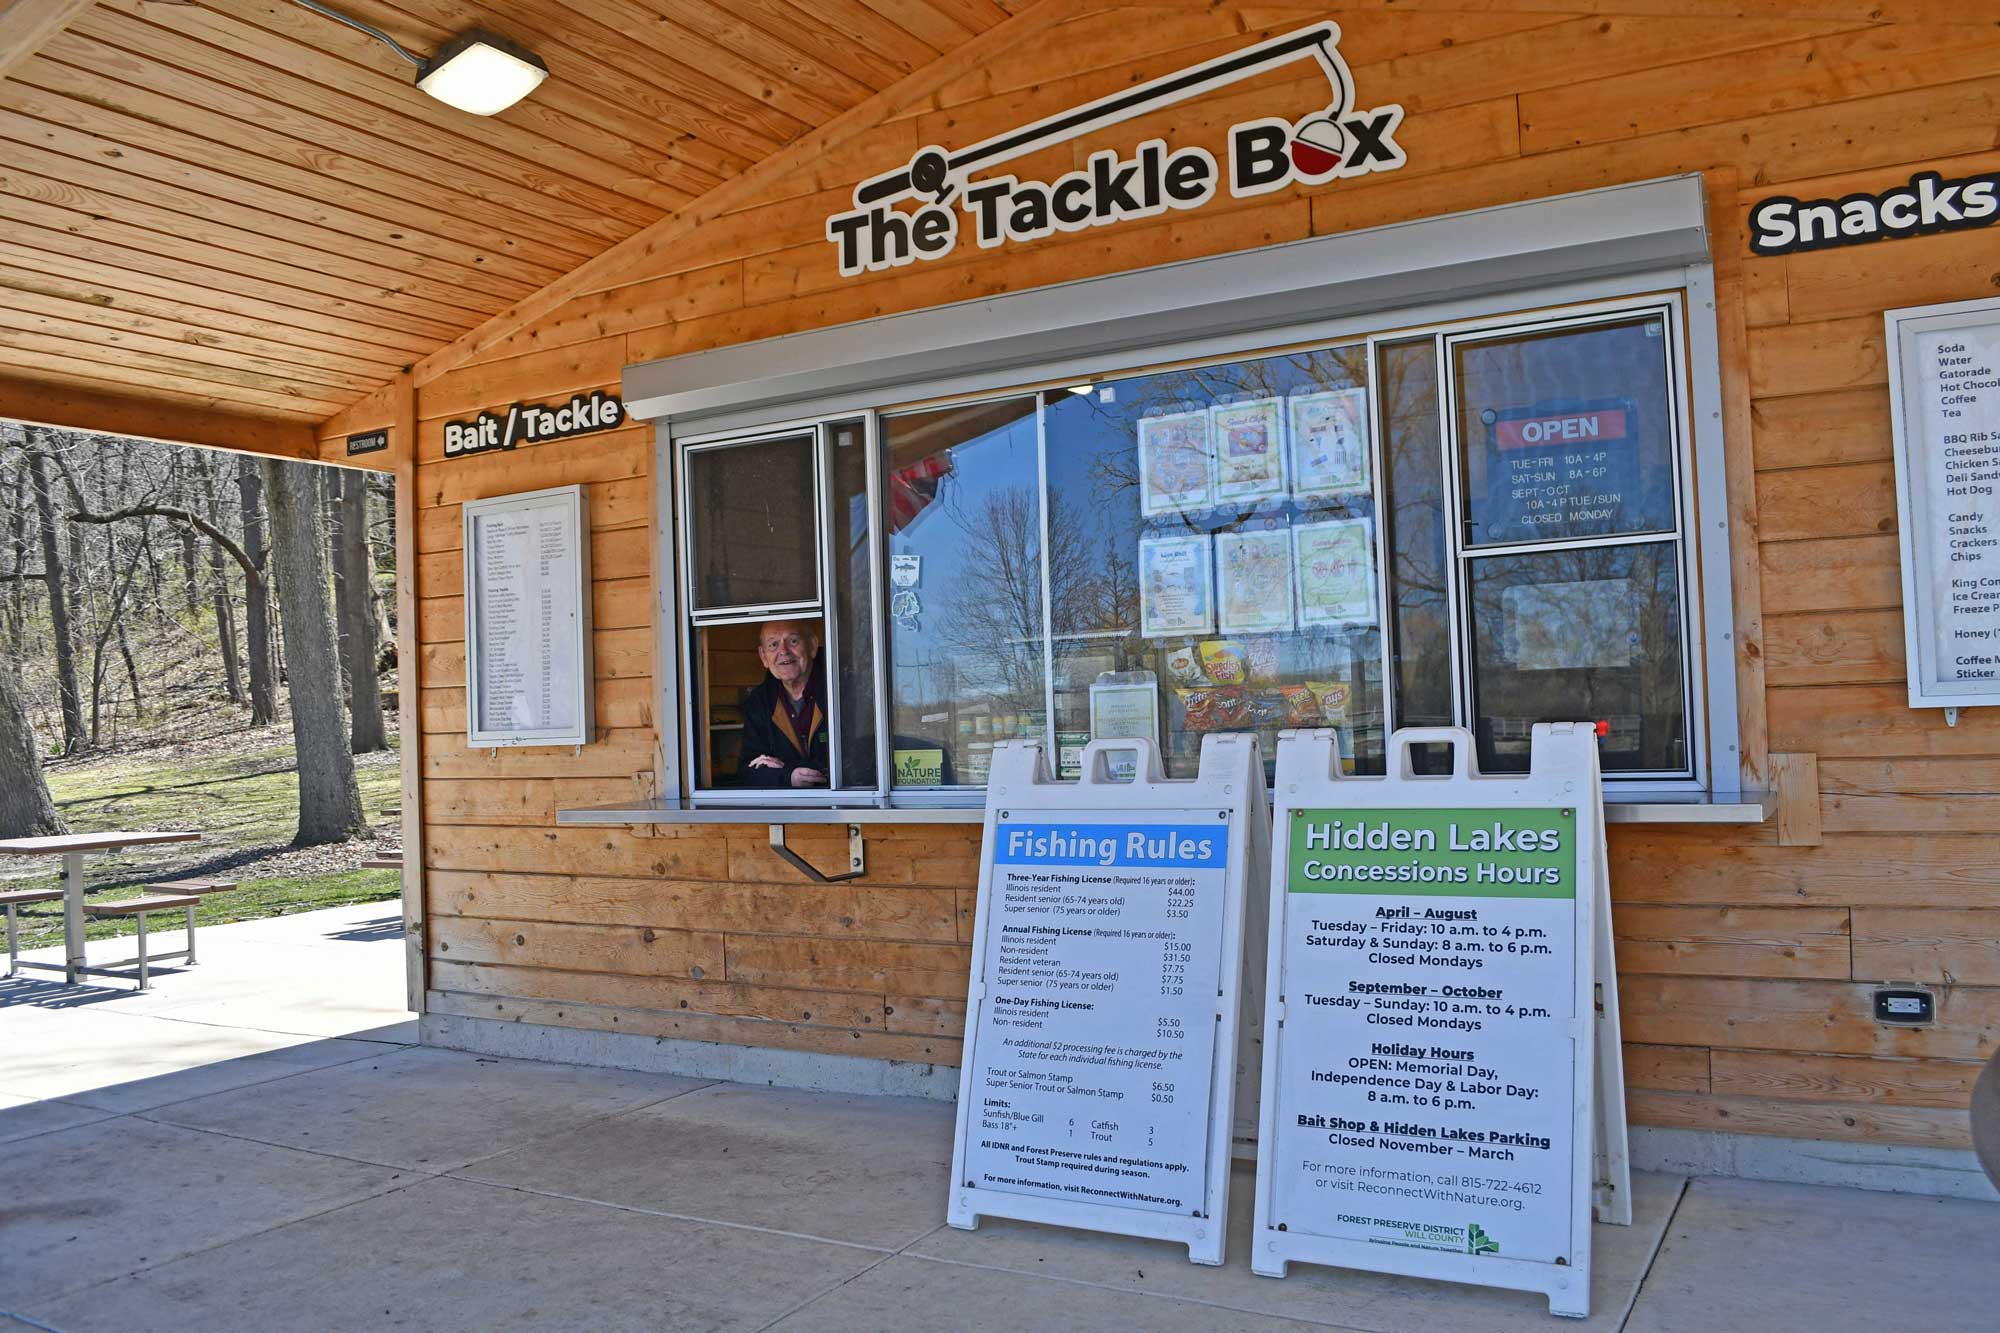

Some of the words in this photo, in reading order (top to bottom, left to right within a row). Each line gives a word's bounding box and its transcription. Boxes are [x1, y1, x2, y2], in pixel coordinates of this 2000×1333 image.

[831, 205, 950, 268] The
[967, 147, 1208, 241] Tackle
[1236, 113, 1398, 189] Box
[1757, 178, 1997, 247] Snacks
[1938, 344, 1965, 354] Soda
[1939, 357, 1972, 366] Water
[1940, 366, 1991, 379] Gatorade
[1940, 384, 1960, 392] Hot
[1941, 395, 1976, 405] Coffee
[1942, 410, 1962, 418] Tea
[446, 416, 498, 453] Bait
[522, 396, 618, 437] Tackle
[1522, 416, 1598, 442] OPEN
[1944, 434, 1967, 444] BBQ
[1970, 432, 1988, 442] Rib
[1946, 458, 1989, 470] Chicken
[1946, 474, 1968, 483] Deli
[1947, 487, 1967, 496] Hot
[1970, 486, 1992, 496] Dog
[1522, 513, 1562, 524] CLOSED
[1570, 509, 1613, 521] MONDAY
[1948, 512, 1984, 522] Candy
[1949, 524, 1988, 536] Snacks
[1950, 538, 1998, 549] Crackers
[1951, 552, 1982, 562] Chips
[1952, 578, 1977, 590] King
[1954, 604, 1990, 614] Freeze
[1955, 630, 1990, 640] Honey
[1956, 656, 1992, 665] Coffee
[1956, 669, 1995, 678] Sticker
[898, 768, 940, 778] NATURE
[1306, 820, 1434, 849] Hidden
[1449, 822, 1558, 850] Lakes
[1008, 830, 1116, 865] Fishing
[1126, 831, 1212, 859] Rules
[1303, 859, 1467, 881] Concessions
[1476, 862, 1559, 883] Hours
[1007, 873, 1050, 882] Three-Year
[1050, 874, 1080, 884] Fishing
[1081, 874, 1112, 883] License
[1113, 875, 1141, 885] (Required
[1143, 876, 1149, 884] 16
[1150, 878, 1166, 886] years
[1174, 876, 1195, 886] older):
[1005, 883, 1029, 892] Illinois
[1030, 884, 1061, 893] resident
[1168, 887, 1195, 896] $44.00
[1375, 905, 1409, 918] April
[1424, 907, 1477, 920] August
[1311, 919, 1367, 934] Tuesday
[1381, 921, 1427, 936] Friday:
[1430, 923, 1445, 934] 10
[1448, 926, 1478, 935] a.m.
[1482, 925, 1497, 936] to
[1501, 925, 1511, 936] 4
[1515, 928, 1546, 939] p.m.
[1306, 934, 1366, 950] Saturday
[1369, 936, 1378, 948] &
[1382, 937, 1438, 952] Sunday:
[1441, 939, 1451, 950] 8
[1454, 942, 1484, 952] a.m.
[1488, 941, 1503, 952] to
[1507, 941, 1516, 952] 6
[1520, 944, 1552, 955] p.m.
[1000, 945, 1048, 955] Non-resident
[1163, 952, 1190, 962] $31.50
[1368, 952, 1414, 965] Closed
[1419, 954, 1483, 970] Mondays
[999, 955, 1030, 965] Resident
[1032, 958, 1060, 966] veteran
[1162, 963, 1184, 973] $7.75
[1348, 980, 1427, 995] September
[1441, 985, 1503, 998] October
[995, 995, 1029, 1007] One-Day
[1030, 998, 1059, 1010] Fishing
[1061, 1000, 1094, 1010] License:
[1012, 1018, 1042, 1028] resident
[1156, 1028, 1184, 1039] $10.50
[1371, 1042, 1426, 1057] Holiday
[1430, 1046, 1474, 1060] Hours
[1348, 1057, 1392, 1070] OPEN:
[1396, 1060, 1462, 1076] Memorial
[1467, 1065, 1498, 1080] Day,
[987, 1066, 1007, 1077] Trout
[1017, 1069, 1046, 1080] Salmon
[1047, 1072, 1073, 1084] Stamp
[1152, 1081, 1174, 1092] $6.50
[1311, 1070, 1410, 1088] Independence
[1414, 1077, 1442, 1093] Day
[1446, 1080, 1455, 1092] &
[1460, 1081, 1502, 1095] Labor
[1506, 1084, 1538, 1100] Day:
[983, 1097, 1010, 1108] Limits:
[1030, 1113, 1044, 1123] Gill
[1068, 1118, 1074, 1126] 6
[1091, 1119, 1118, 1131] Catfish
[1148, 1125, 1154, 1134] 3
[1297, 1114, 1326, 1126] Bait
[1329, 1117, 1365, 1130] Shop
[1369, 1120, 1379, 1131] &
[1383, 1121, 1436, 1137] Hidden
[1440, 1126, 1484, 1141] Lakes
[1489, 1130, 1550, 1148] Parking
[1328, 1133, 1374, 1148] Closed
[1379, 1138, 1453, 1155] November
[1468, 1146, 1514, 1161] March
[1302, 1160, 1321, 1172] For
[1324, 1164, 1356, 1175] more
[1359, 1165, 1433, 1185] information,
[1436, 1175, 1458, 1186] call
[1461, 1176, 1542, 1194] 815-722-4612
[983, 1173, 996, 1182] For
[996, 1176, 1016, 1184] more
[1016, 1177, 1062, 1191] information,
[1063, 1183, 1079, 1192] visit
[1080, 1185, 1182, 1207] ReconnectWithNature.org.
[1315, 1178, 1328, 1187] or
[1330, 1178, 1354, 1191] visit
[1357, 1181, 1525, 1211] ReconnectWithNature.org.
[1337, 1214, 1371, 1225] FOREST
[1373, 1218, 1420, 1231] PRESERVE
[1423, 1223, 1464, 1235] DISTRICT
[1404, 1229, 1426, 1239] WILL
[1428, 1232, 1464, 1243] COUNTY
